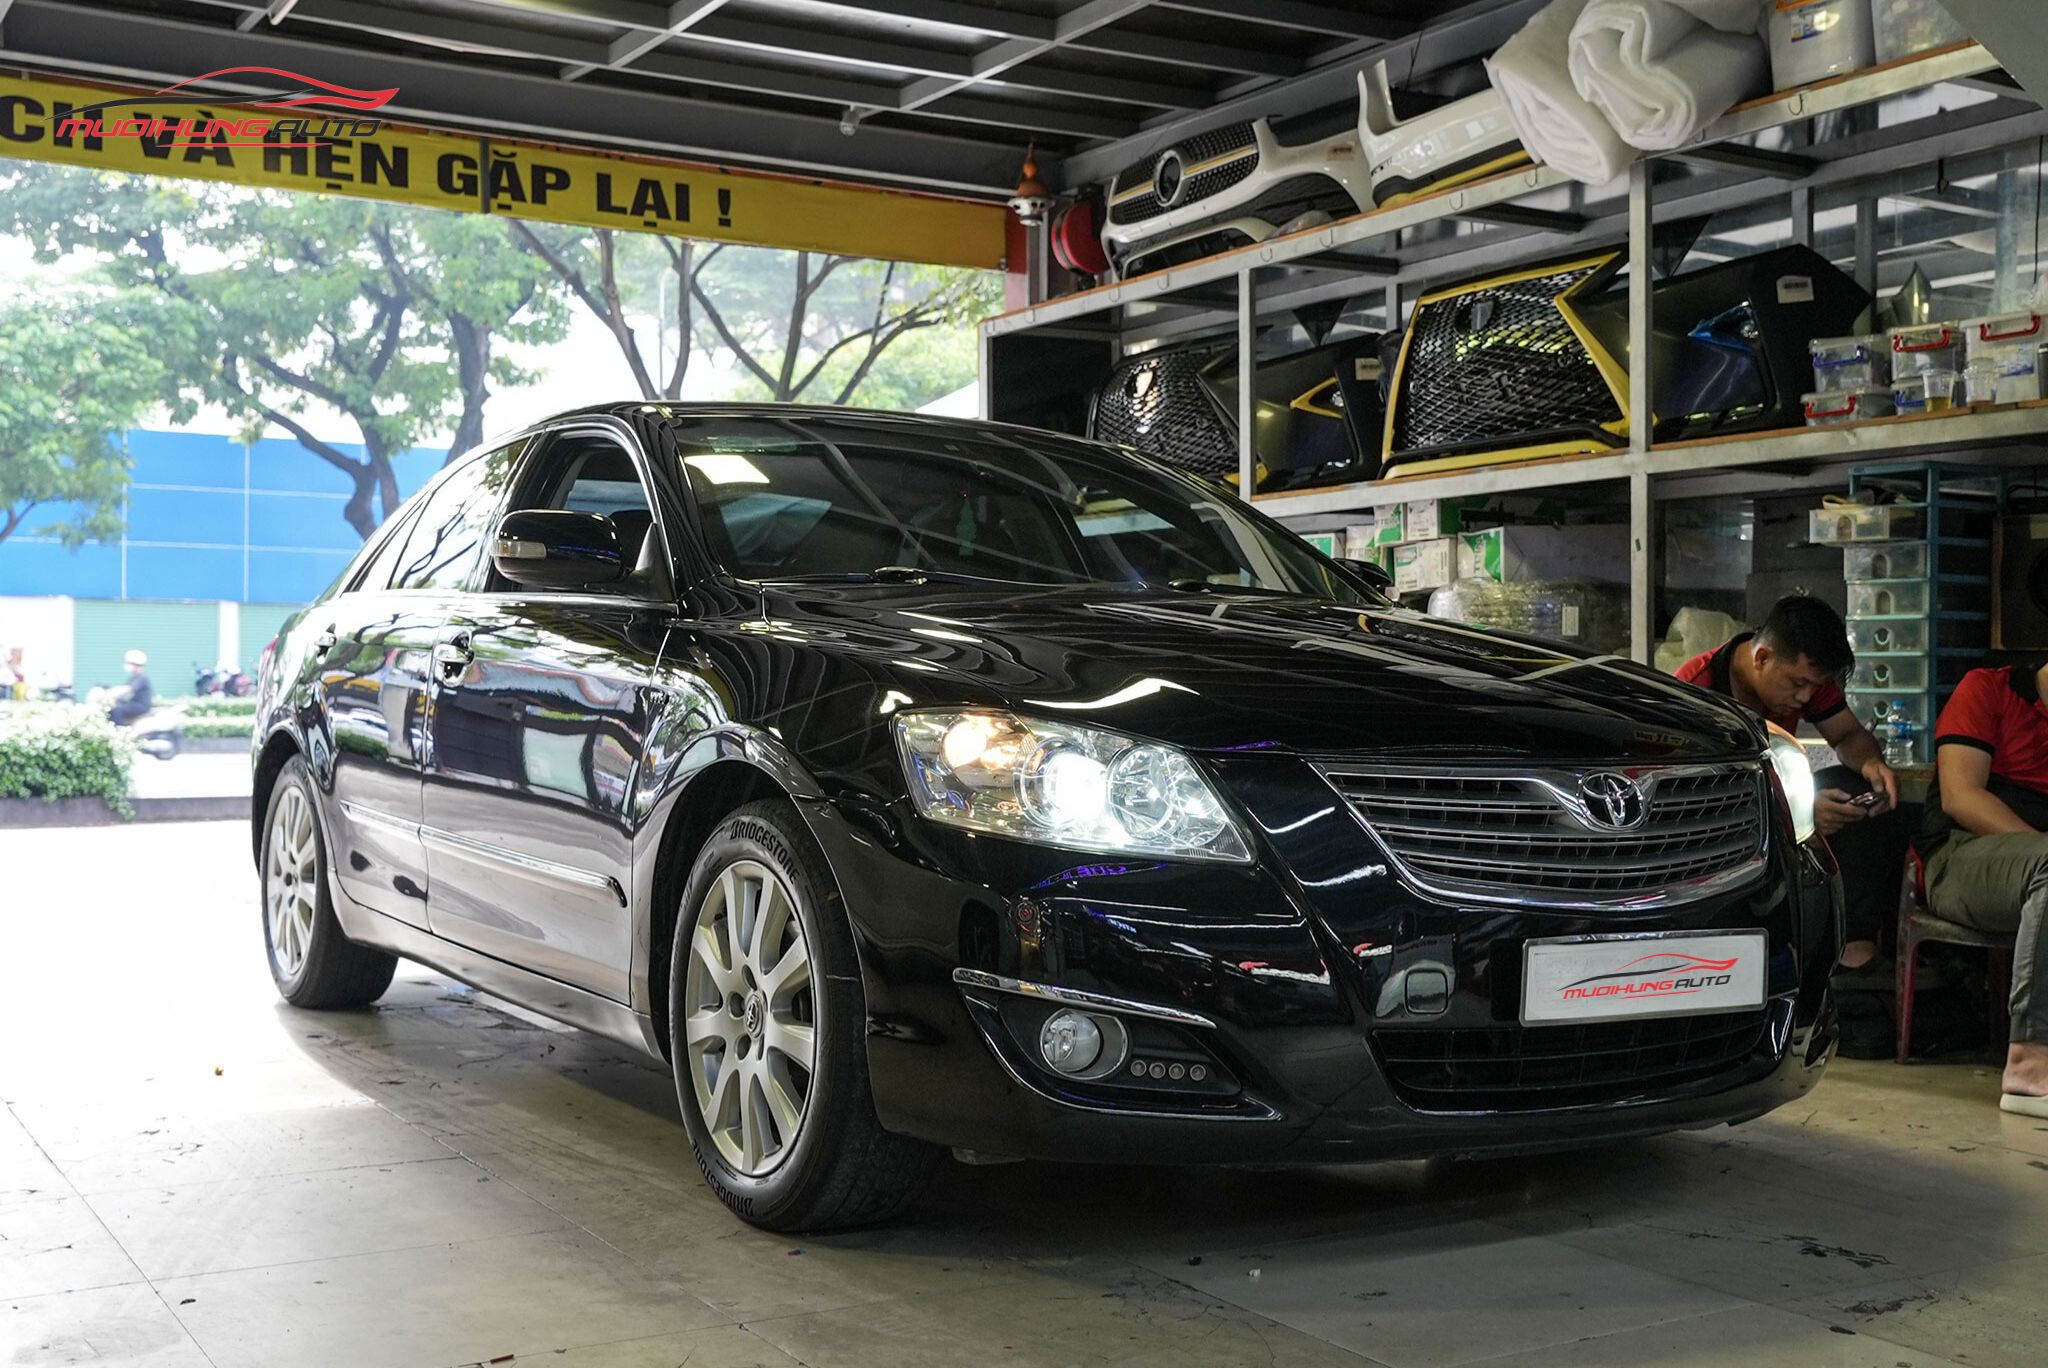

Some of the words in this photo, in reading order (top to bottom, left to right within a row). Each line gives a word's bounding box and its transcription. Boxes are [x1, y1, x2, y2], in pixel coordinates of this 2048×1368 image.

[133, 109, 235, 168] VÀ
[263, 129, 409, 190] HẸN
[437, 150, 571, 210] GẶP
[596, 172, 690, 227] LẠI
[717, 187, 732, 227] !
[729, 820, 801, 885] BRIDGESTONE
